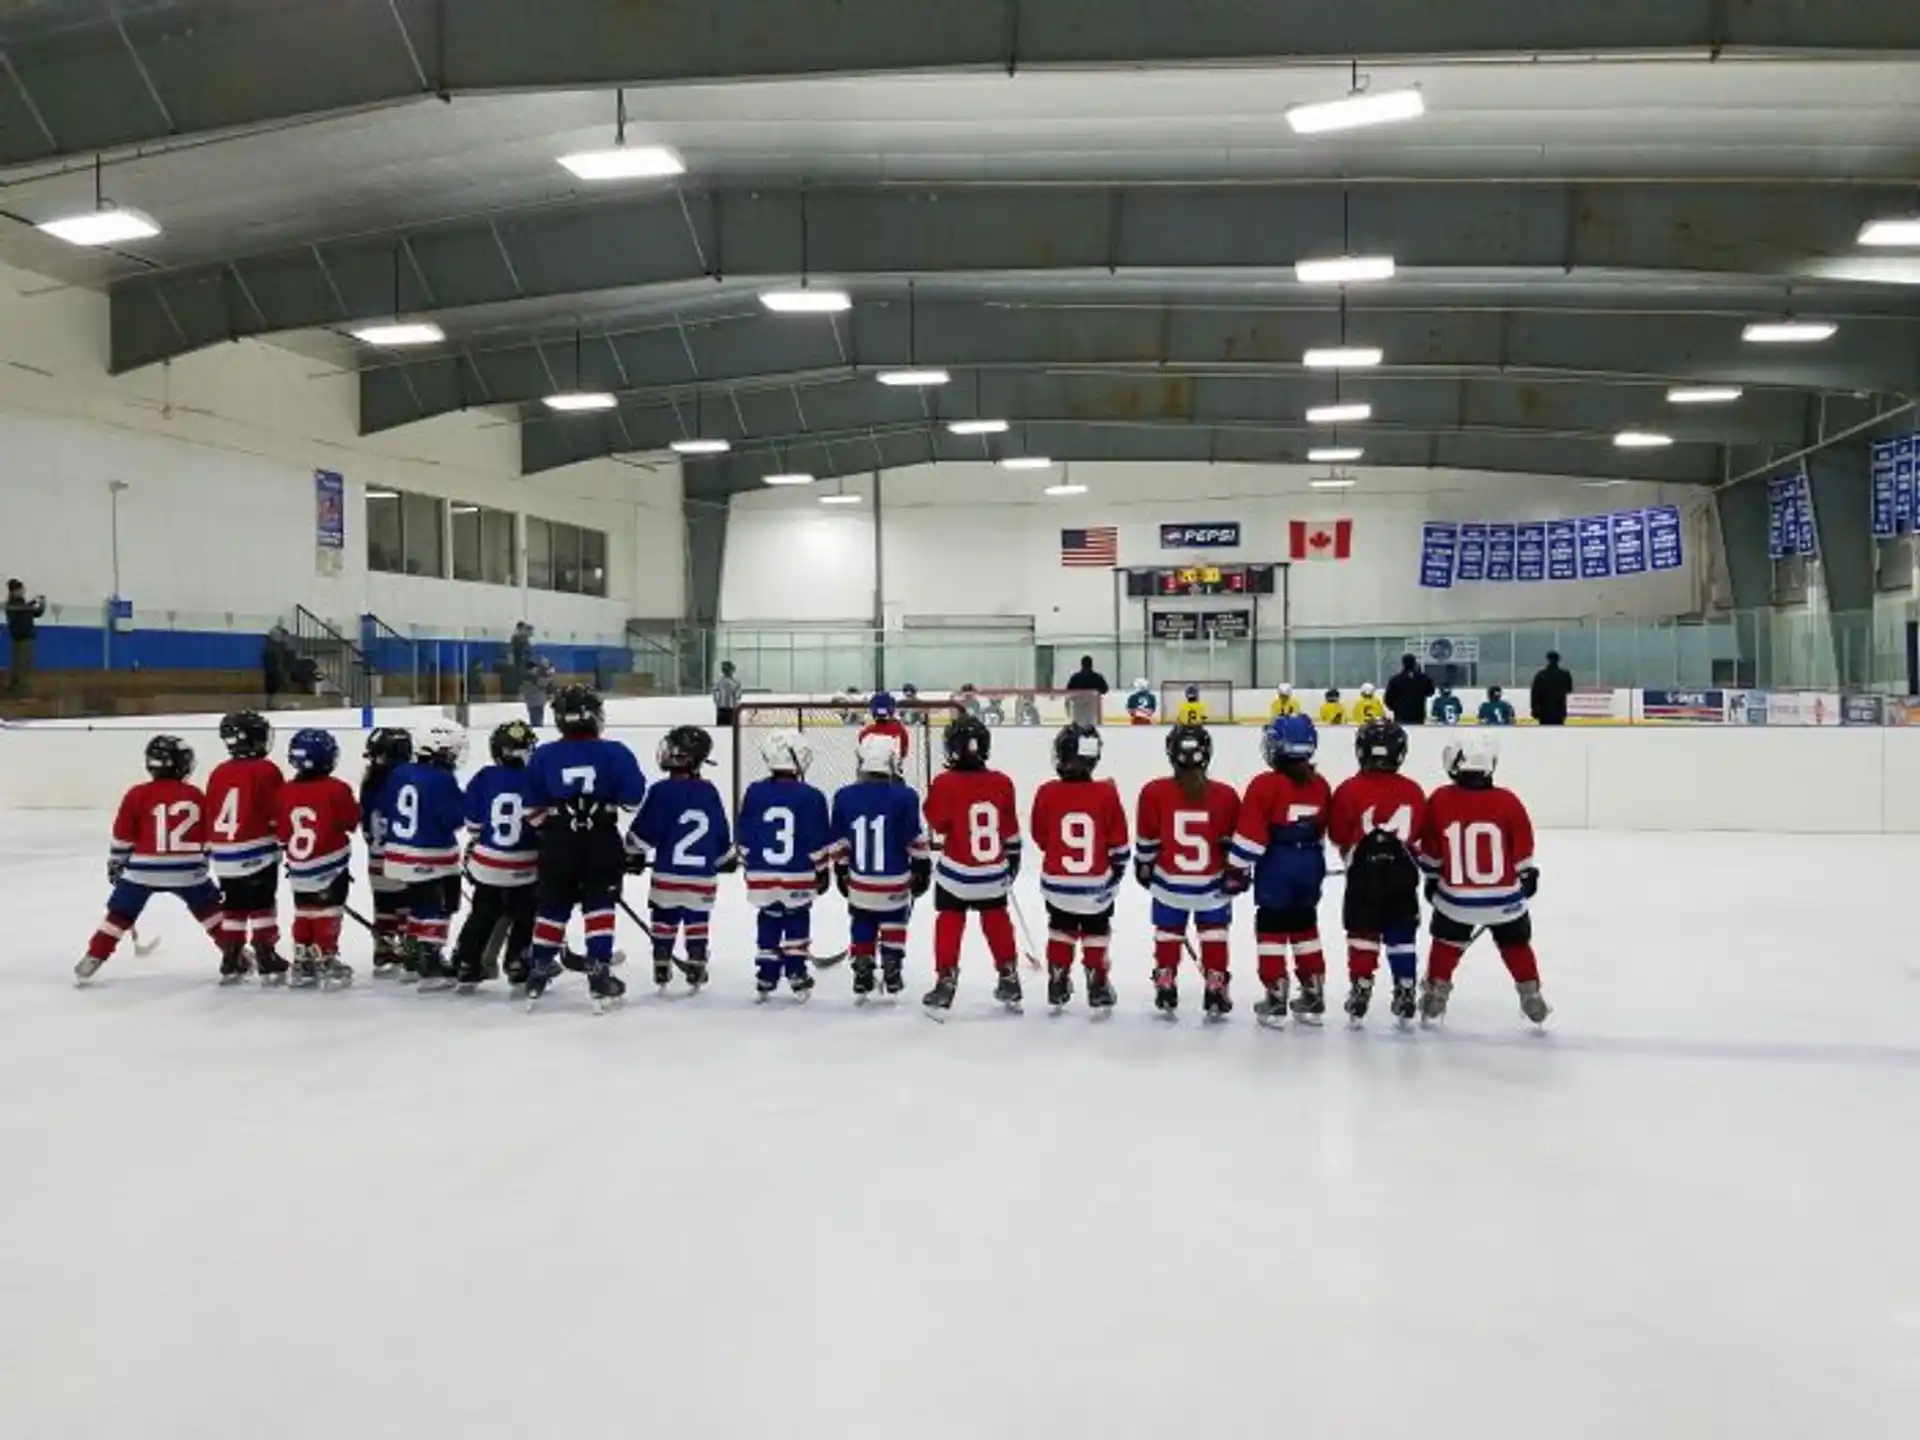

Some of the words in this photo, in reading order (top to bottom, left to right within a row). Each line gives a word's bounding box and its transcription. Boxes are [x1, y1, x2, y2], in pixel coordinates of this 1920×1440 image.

[1184, 529, 1236, 542] PEPSI
[153, 800, 201, 852] 12
[213, 787, 239, 841] 4
[288, 807, 317, 860] 6
[392, 784, 419, 839] 9
[490, 792, 523, 846] 8
[671, 809, 709, 866] 2
[762, 806, 795, 865] 3
[969, 801, 1001, 862] 8
[851, 814, 885, 873] 11
[1061, 812, 1095, 874] 9
[1173, 811, 1209, 872] 5
[1443, 821, 1504, 885] 10
